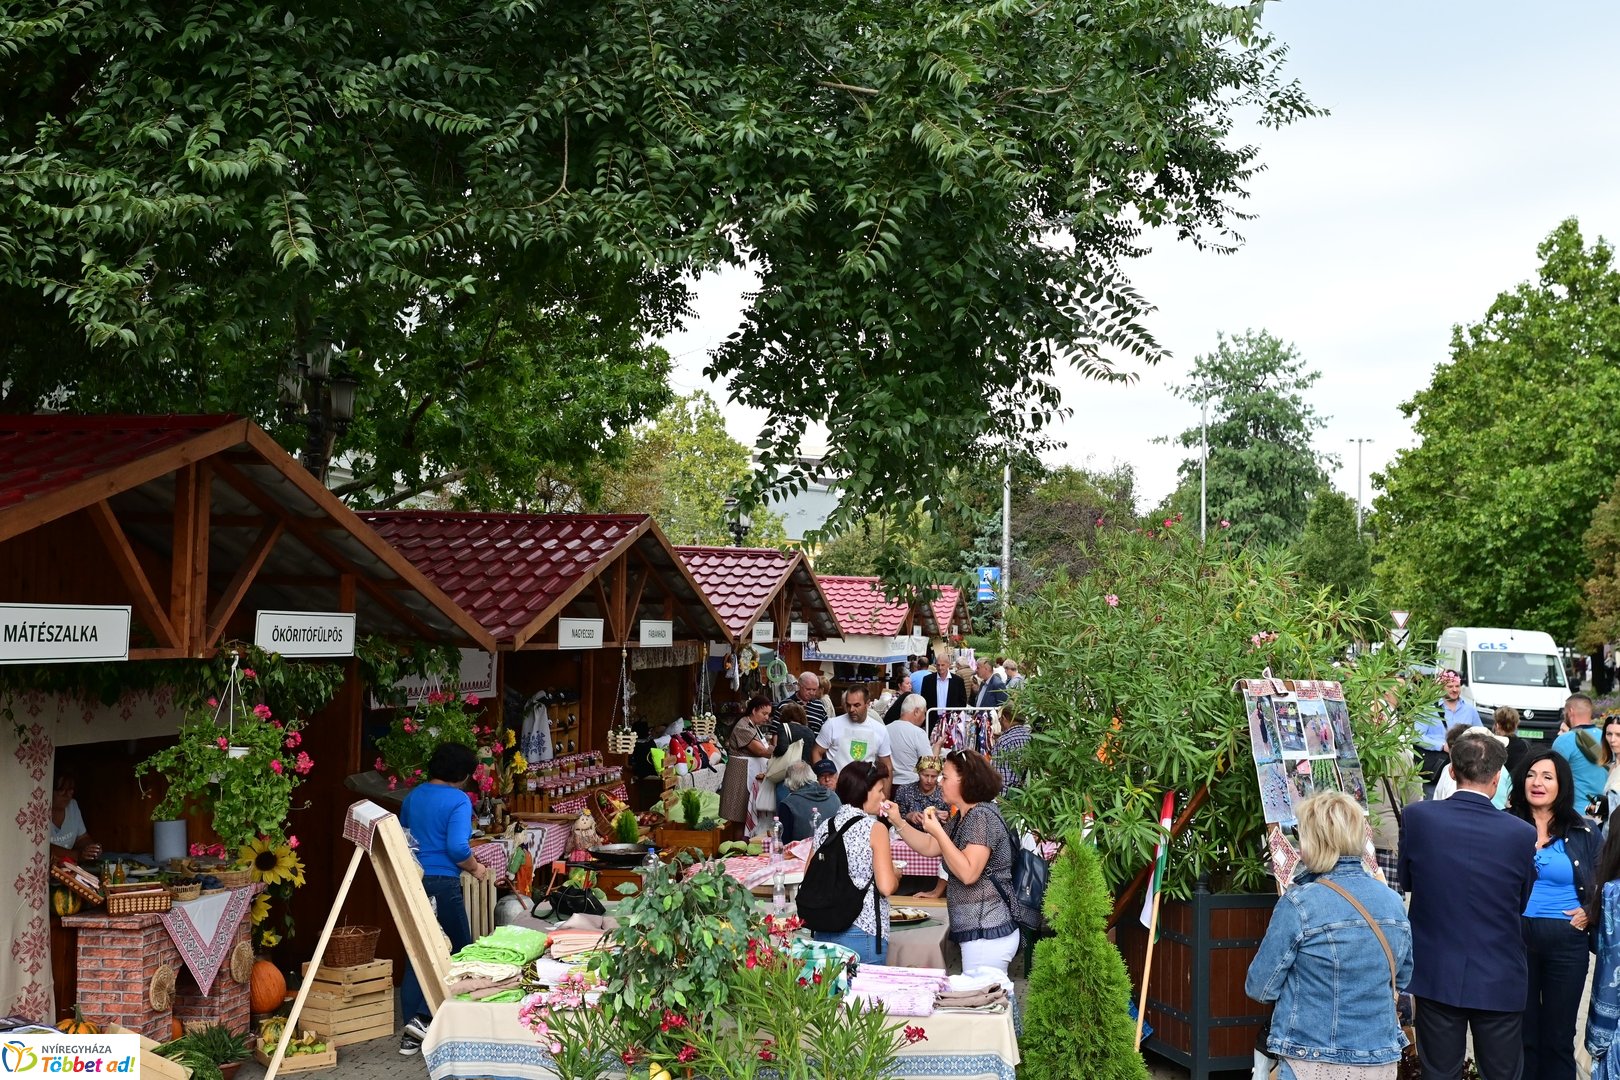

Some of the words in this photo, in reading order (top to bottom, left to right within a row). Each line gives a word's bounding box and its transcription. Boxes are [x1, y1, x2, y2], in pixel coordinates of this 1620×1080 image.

[3, 621, 98, 642] MÁTÉSZALKA
[272, 625, 343, 642] ÖKÖRITÓFÜLPÖS
[571, 628, 594, 638] NAGYECSED
[1478, 642, 1508, 650] GLS
